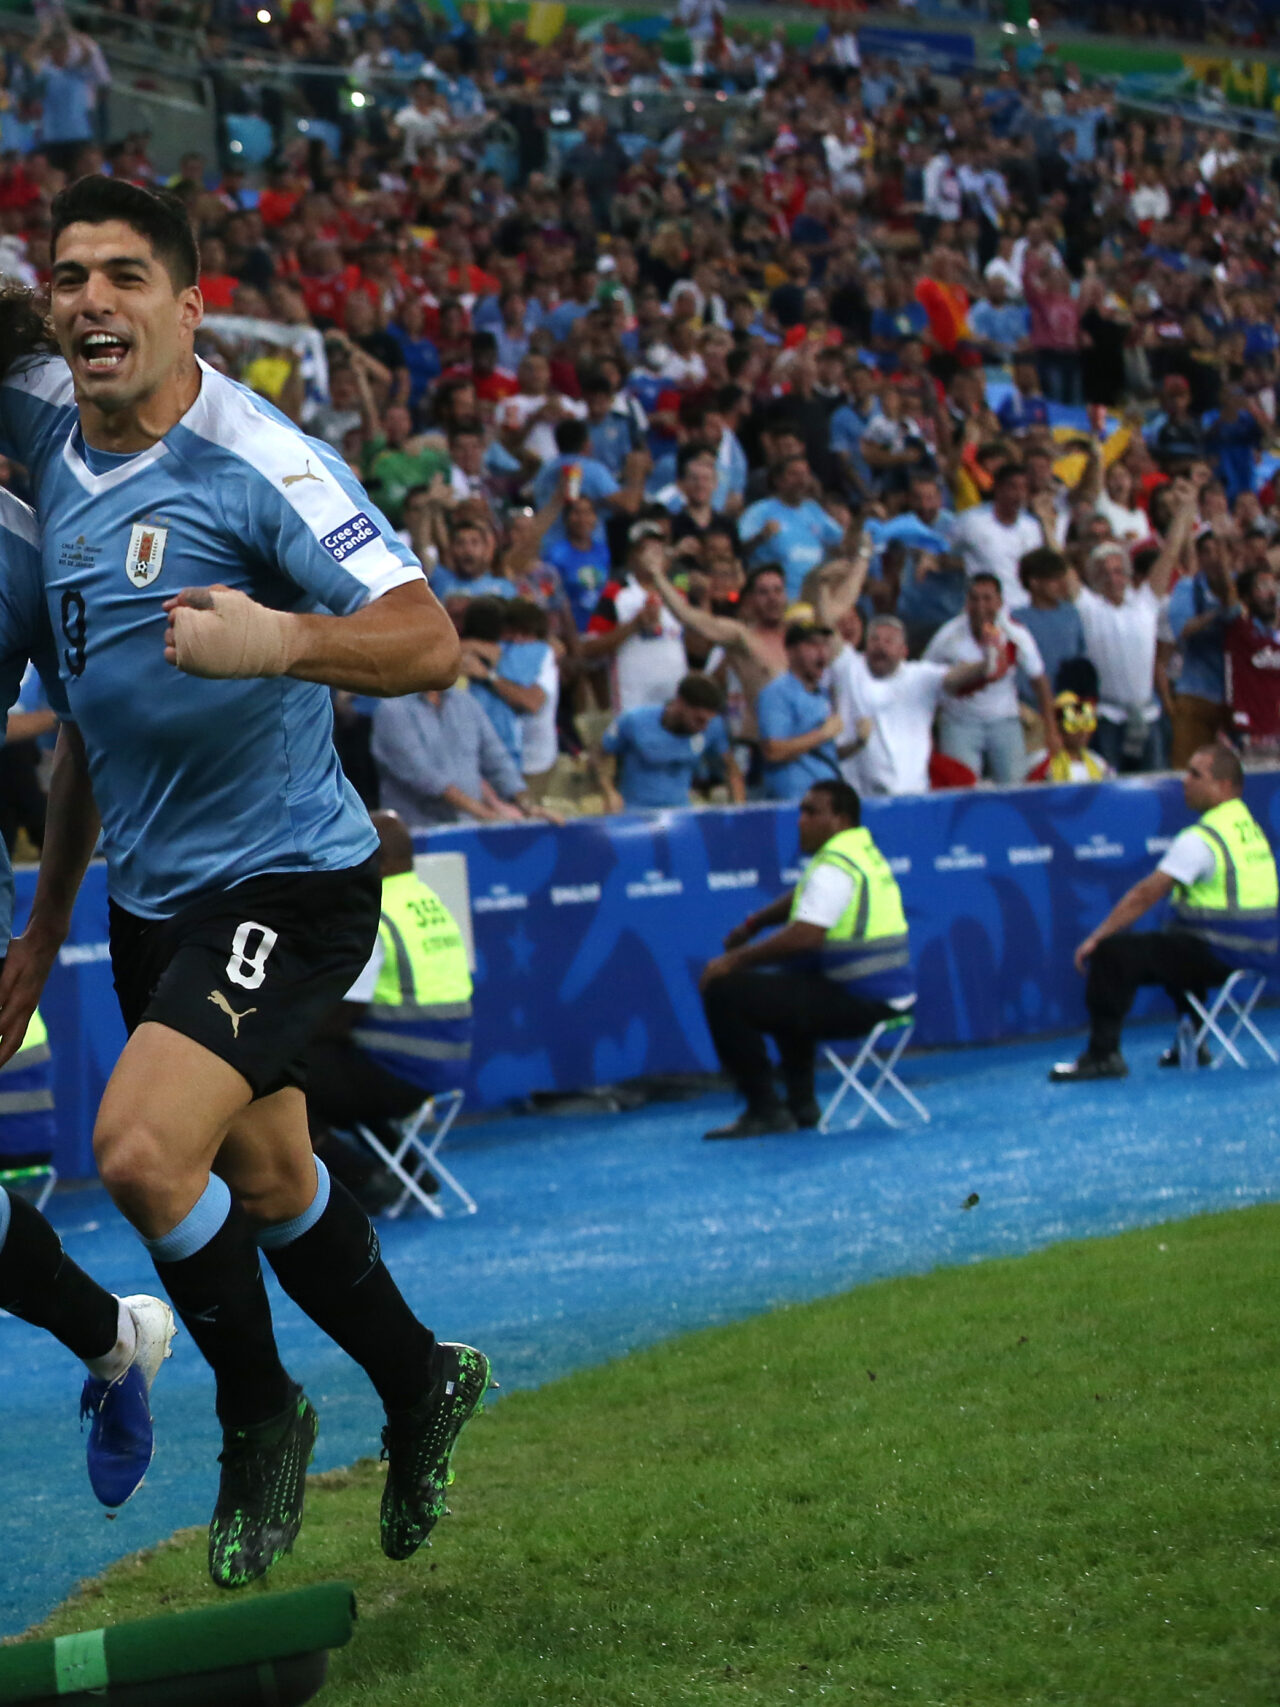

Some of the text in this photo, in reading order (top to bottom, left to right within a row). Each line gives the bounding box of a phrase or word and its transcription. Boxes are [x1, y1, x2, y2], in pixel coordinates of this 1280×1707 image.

[324, 517, 369, 548] Cree en
[333, 527, 373, 559] grande
